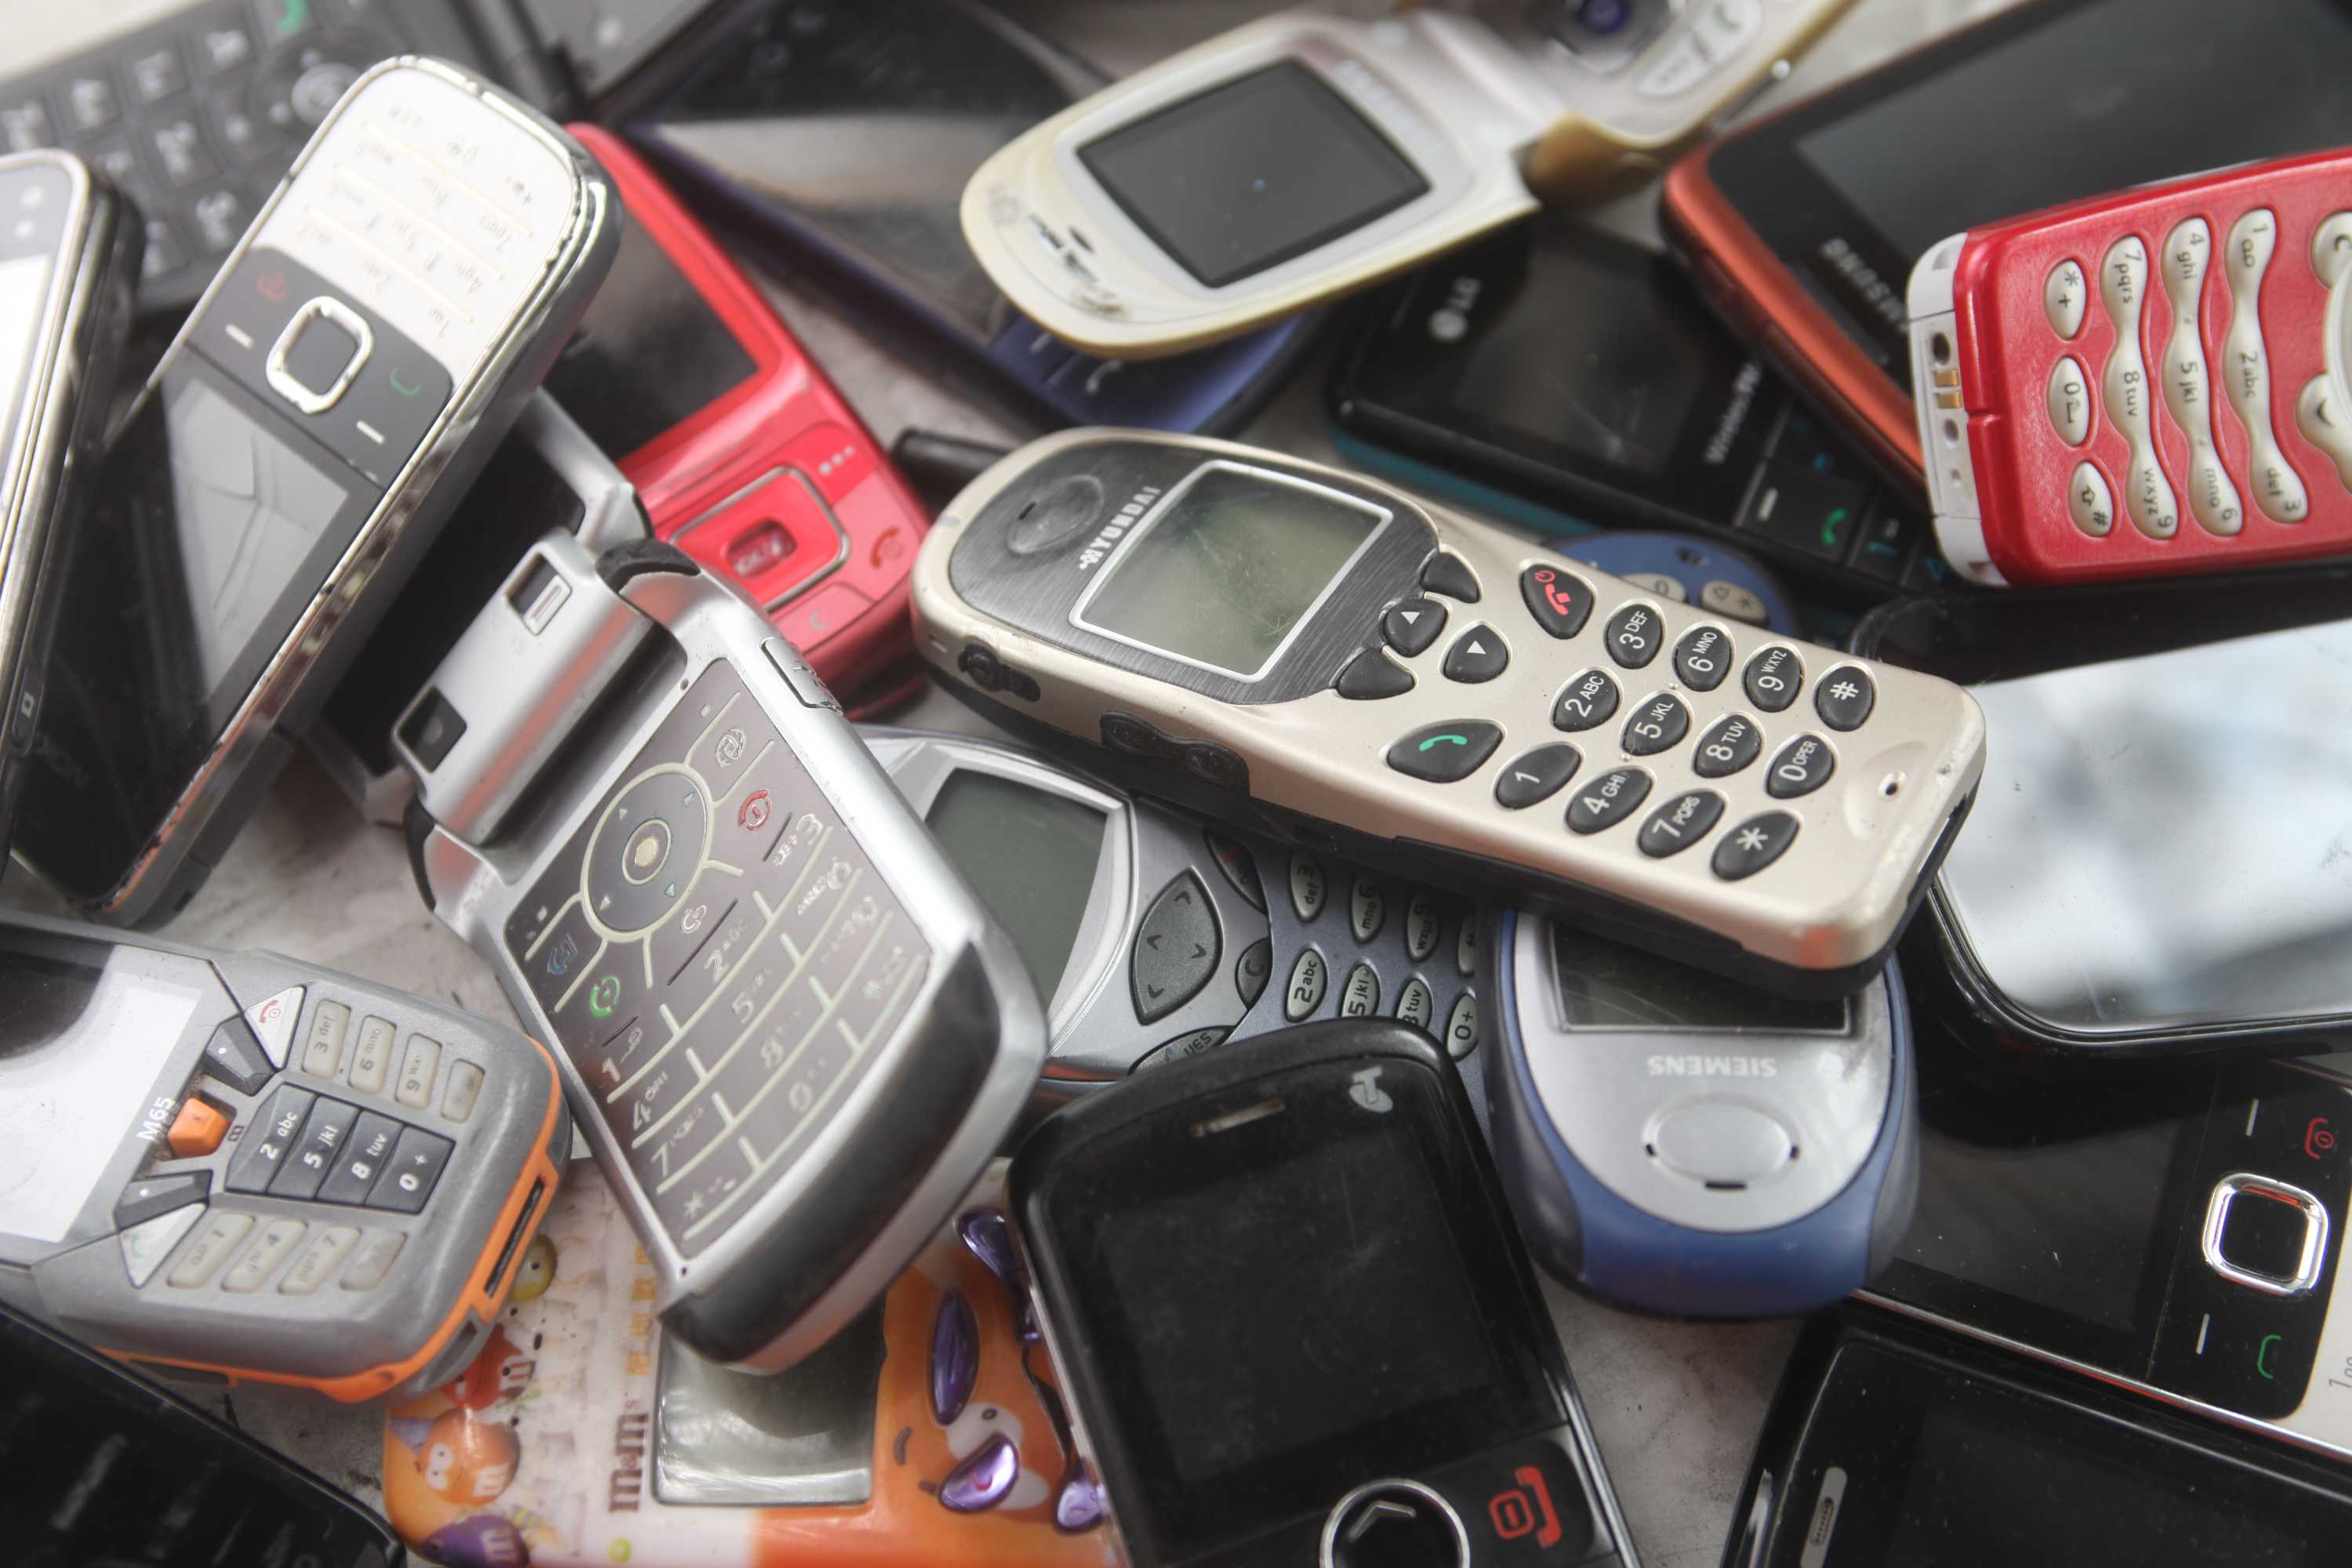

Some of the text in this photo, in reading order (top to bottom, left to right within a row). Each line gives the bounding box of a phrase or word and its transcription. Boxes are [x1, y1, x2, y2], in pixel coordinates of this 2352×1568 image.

[2252, 223, 2270, 234] 1
[2114, 249, 2142, 303] 7 pqrs
[2176, 232, 2205, 280] 4 ghi
[1450, 277, 1483, 312] LG
[1820, 237, 1910, 332] MSUNG
[2058, 293, 2071, 308] +
[2063, 381, 2081, 396] 0
[2123, 370, 2140, 417] 8 tuv
[2179, 361, 2198, 403] 5 jkl
[2241, 351, 2259, 398] 2 abc
[2143, 468, 2174, 528] wxyz 9
[2205, 467, 2239, 521] mno 6
[2267, 467, 2301, 513] def 3
[1079, 485, 1163, 570] HYUNDAI
[2092, 510, 2110, 528] #
[1619, 610, 1648, 650] 3 DEF
[1687, 631, 1718, 672] 6 MNO
[1758, 649, 1788, 691] 9 WXYZ
[1564, 675, 1605, 719] 2 ABC
[1829, 681, 1858, 701] #
[1634, 702, 1675, 739] 5 JKL
[1705, 720, 1747, 761] 8 TUV
[1515, 771, 1541, 785] 1
[1778, 739, 1819, 782] 0 OPER
[1582, 774, 1628, 816] 4 GHI
[795, 813, 824, 846] 3
[1651, 796, 1700, 839] 7 PQRS
[1304, 881, 1319, 905] def
[1361, 901, 1377, 930] mno
[703, 949, 730, 983] 2
[1294, 959, 1318, 1004] 2 abc
[731, 991, 754, 1025] 5
[1348, 979, 1370, 1016] 5 jkl
[1405, 989, 1422, 1013] tuv
[314, 1015, 334, 1054] 3 def
[359, 1028, 382, 1071] 6 mno
[1454, 1024, 1472, 1041] 0
[405, 1080, 421, 1092] 9
[601, 1057, 621, 1083] 1
[1647, 1055, 1778, 1078] SIEMENS
[136, 1097, 176, 1141] M65
[633, 1100, 652, 1131] 4
[259, 1111, 299, 1161] 2 abc
[303, 1124, 340, 1169] 5 jkl
[350, 1132, 389, 1180] 8 tuv
[397, 1152, 428, 1192] 0 +
[650, 1140, 670, 1178] 7
